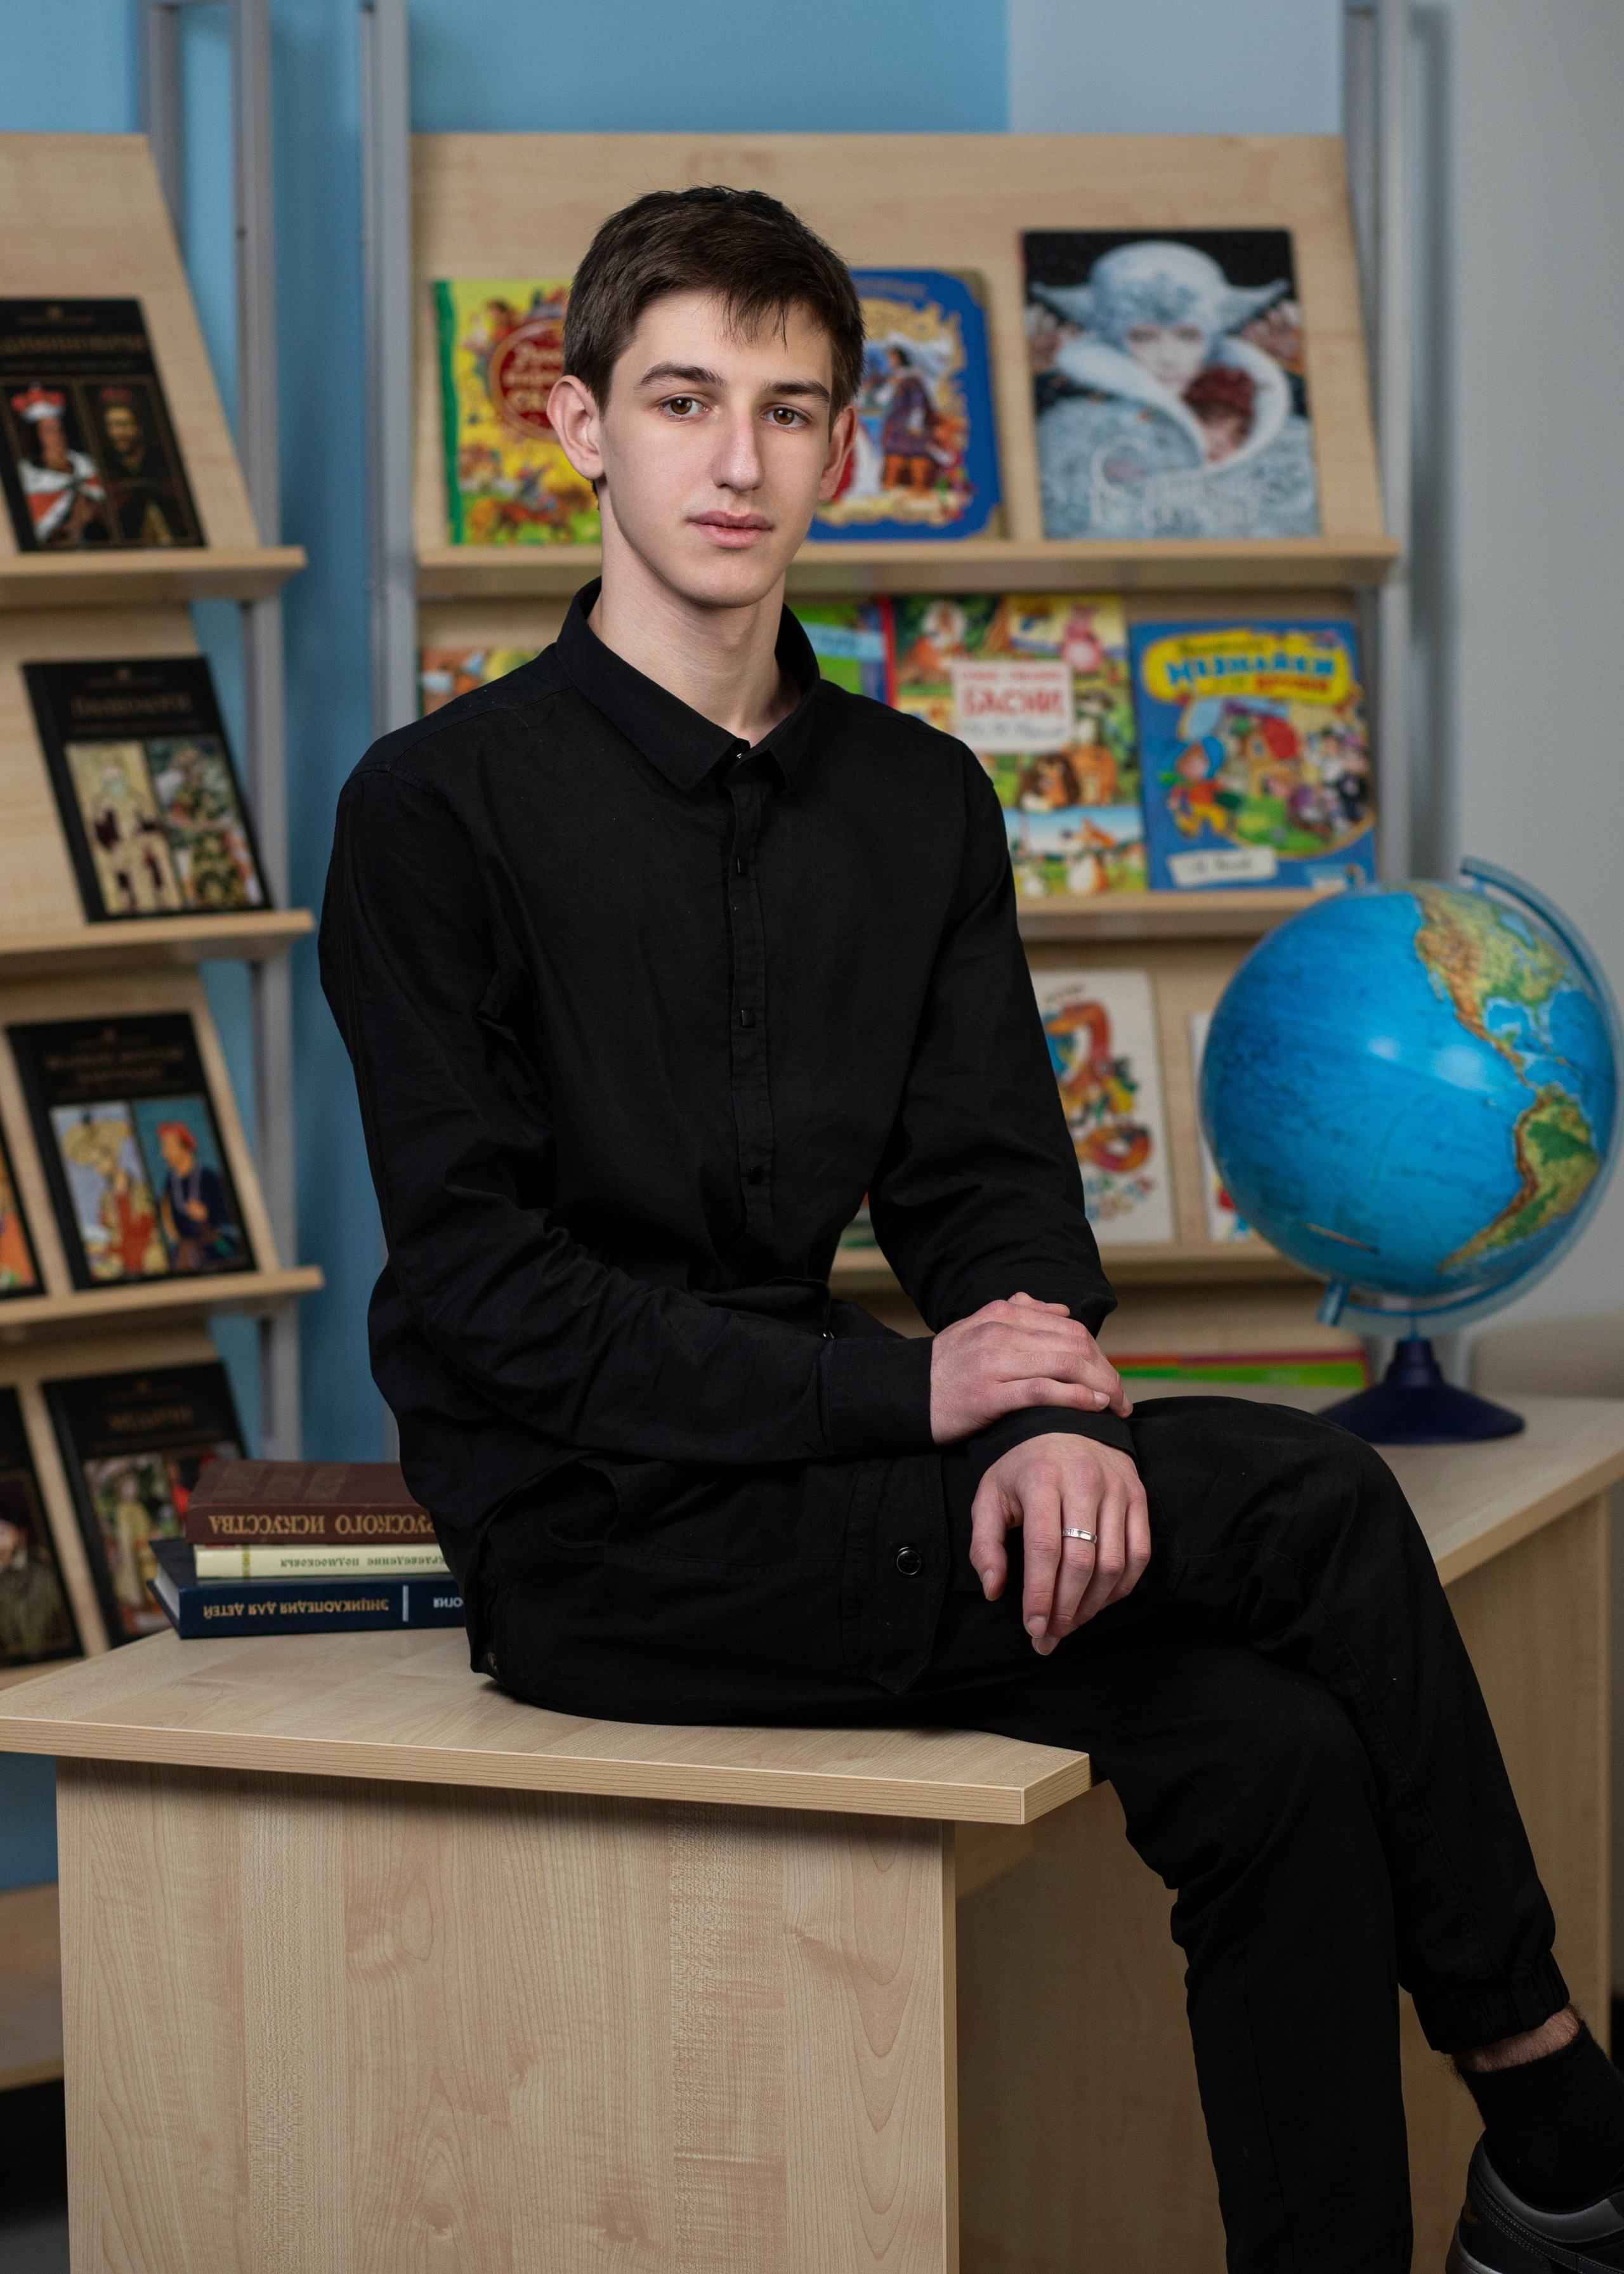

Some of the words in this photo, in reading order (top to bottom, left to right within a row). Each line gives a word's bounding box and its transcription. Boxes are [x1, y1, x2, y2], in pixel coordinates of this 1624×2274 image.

[209, 1514, 325, 1534] ИСКУССТВА
[280, 1557, 360, 1568] ПОДМОСКОВЬЯ
[204, 1602, 244, 1619] ДЕТЕЙ
[248, 1601, 277, 1616] ДЛЯ
[279, 1598, 389, 1615] ЭНЦИКЛОПЕДИЯ
[433, 1597, 464, 1609] ОГИЯ
